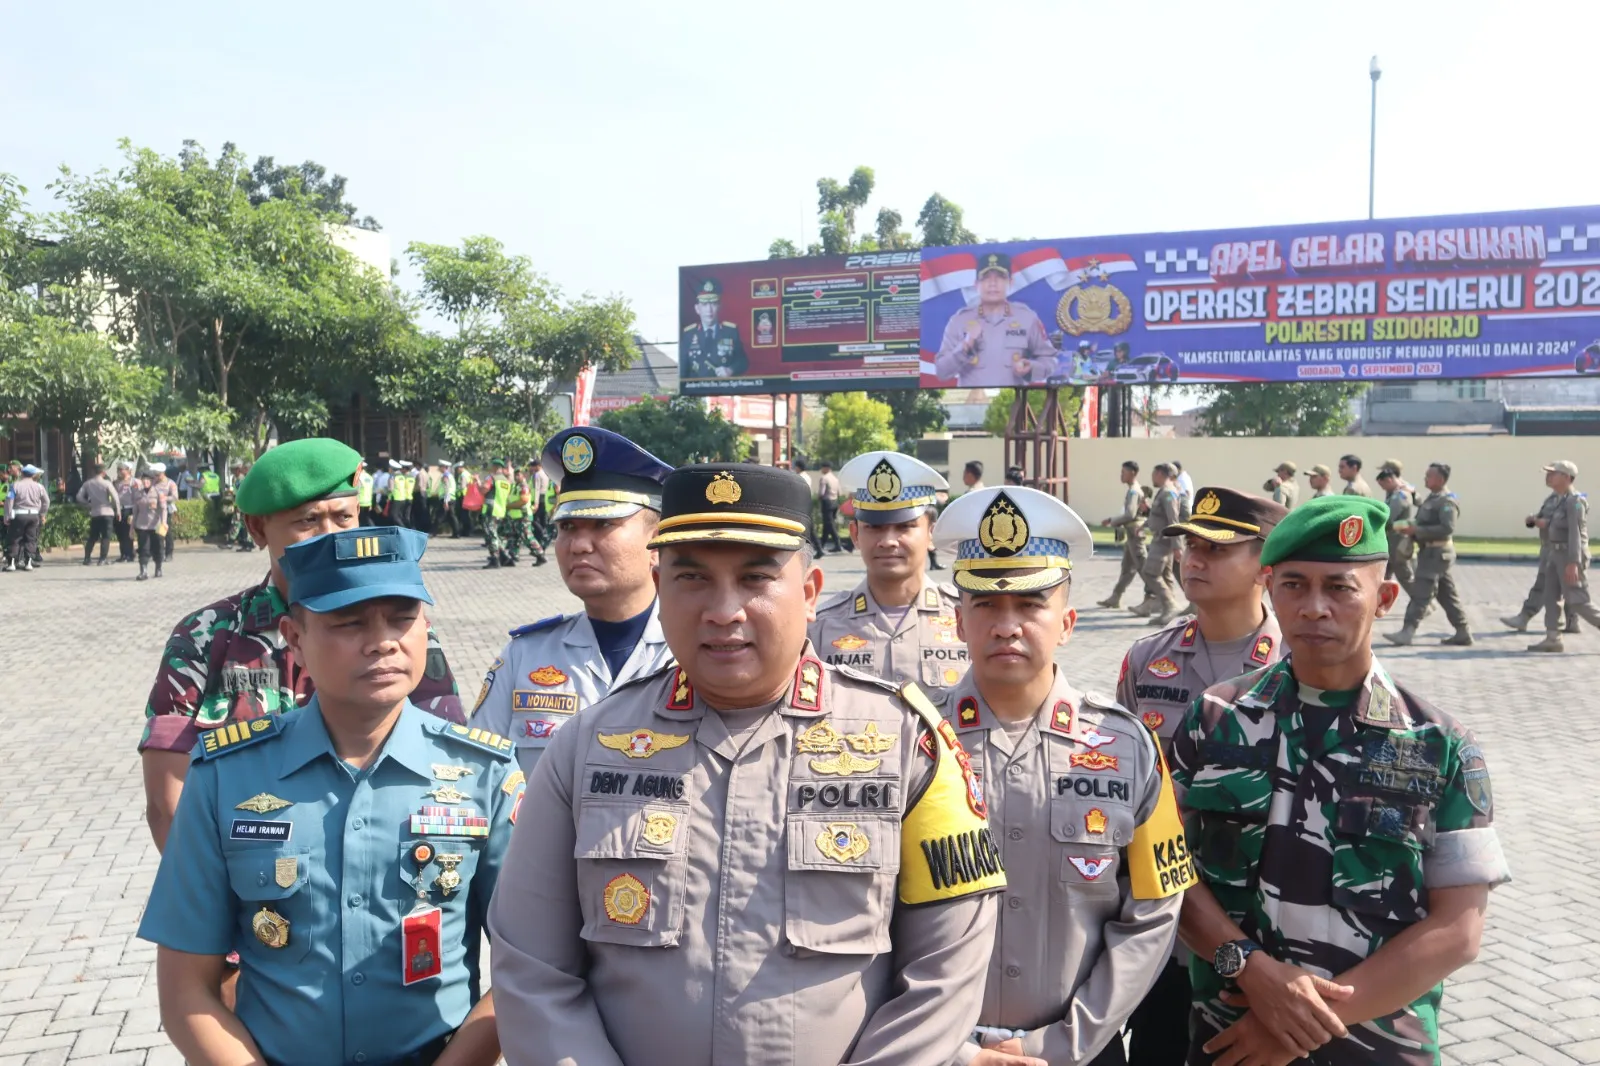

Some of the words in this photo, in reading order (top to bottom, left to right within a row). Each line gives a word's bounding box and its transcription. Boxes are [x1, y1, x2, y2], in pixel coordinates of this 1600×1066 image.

[1209, 239, 1282, 276] APEL
[1290, 232, 1385, 269] GELAR
[1394, 225, 1546, 262] PASUKAN
[1144, 285, 1268, 322] OPERASI
[1276, 281, 1376, 317] ZEBRA
[1386, 274, 1523, 313] SEMERU
[1265, 318, 1366, 344] POLRESTA
[1372, 314, 1480, 340] SIDOARJO
[1305, 348, 1333, 361] YANG
[1336, 346, 1392, 360] KONDUSIF
[1395, 344, 1443, 359] MENUJU
[1447, 343, 1490, 358] PEMILU
[1494, 342, 1534, 357] DAMAI
[526, 694, 574, 710] NOVIANTO
[590, 771, 629, 795] DENY
[632, 773, 684, 800] AGUNG
[797, 783, 892, 808] POLRI
[1057, 776, 1130, 801] POLRI
[236, 824, 257, 834] HELMI
[258, 825, 285, 836] IRAWAN
[1153, 834, 1190, 871] KAS
